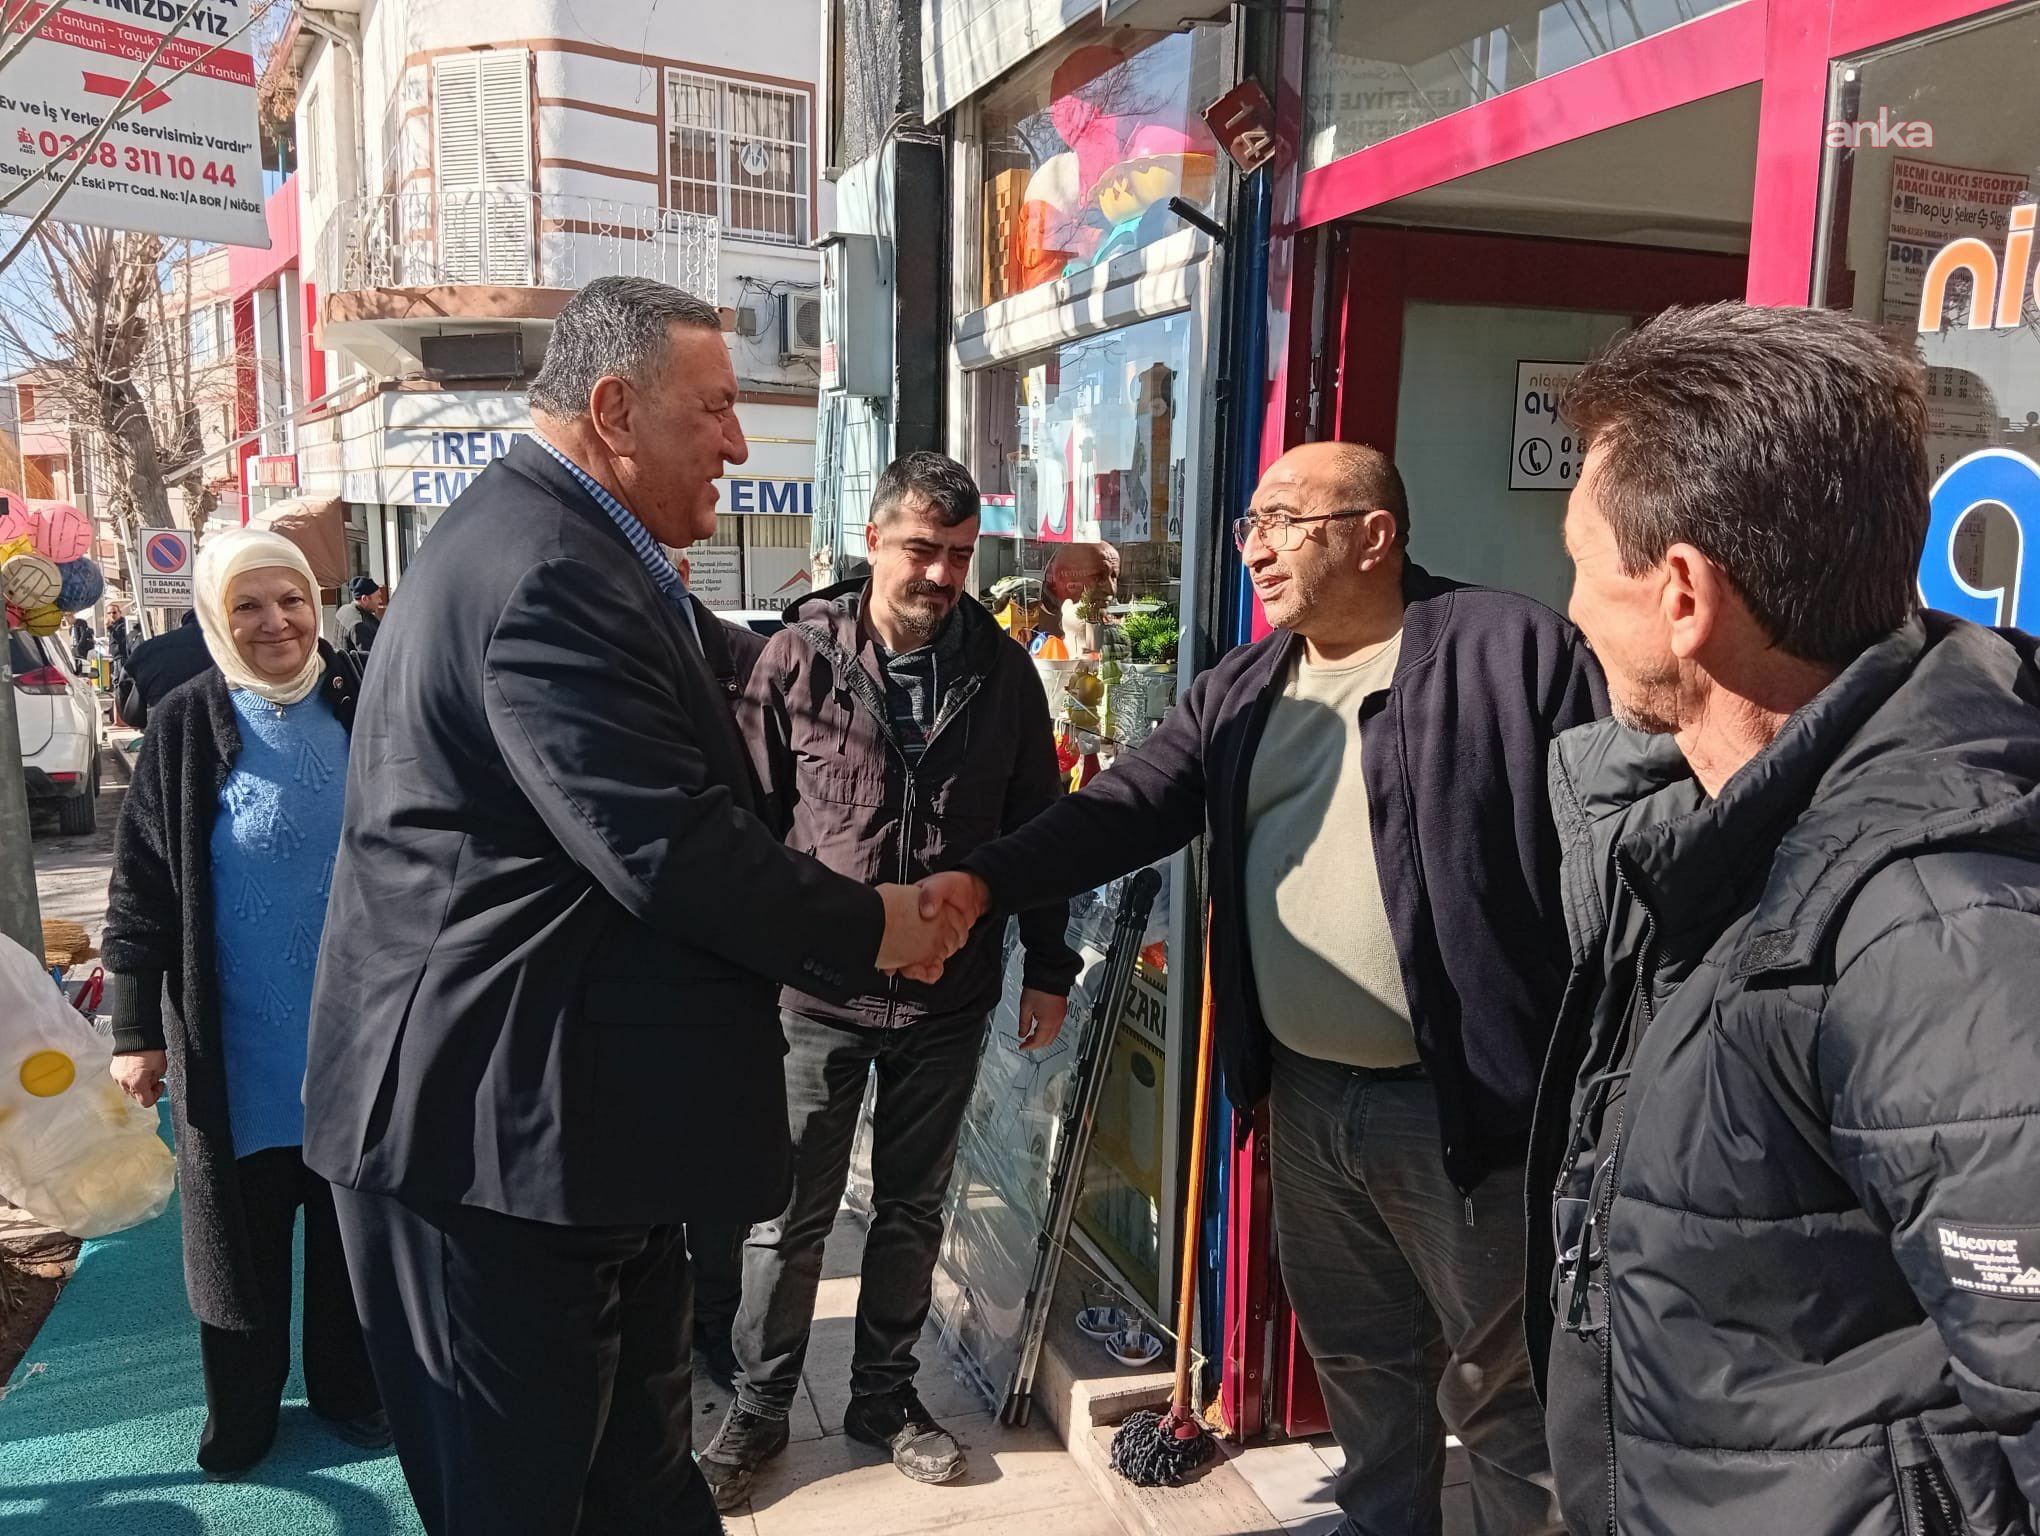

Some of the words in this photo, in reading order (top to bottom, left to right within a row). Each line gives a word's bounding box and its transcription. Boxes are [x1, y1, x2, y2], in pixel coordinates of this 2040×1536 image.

[56, 12, 105, 34] Tantuni
[117, 27, 155, 46] Tavuk
[41, 26, 54, 37] Et
[56, 28, 108, 50] Tantuni
[210, 65, 252, 83] Tantuni
[20, 101, 40, 114] ve
[43, 101, 58, 122] İş
[131, 122, 204, 146] Servisimiz
[124, 146, 162, 177] 311
[167, 153, 195, 180] 10
[202, 161, 237, 187] 44
[82, 176, 106, 189] Eski
[108, 180, 129, 194] PTT
[131, 184, 158, 198] Cad.
[160, 188, 179, 201] No:
[181, 190, 198, 205] 1/A
[199, 194, 222, 208] BOR
[230, 198, 261, 213] NİĞDE
[1889, 243, 1923, 265] BOR
[1917, 200, 2040, 333] ni
[171, 587, 191, 595] PARK
[1938, 1227, 2018, 1253] Discover
[1941, 1246, 1961, 1258] The
